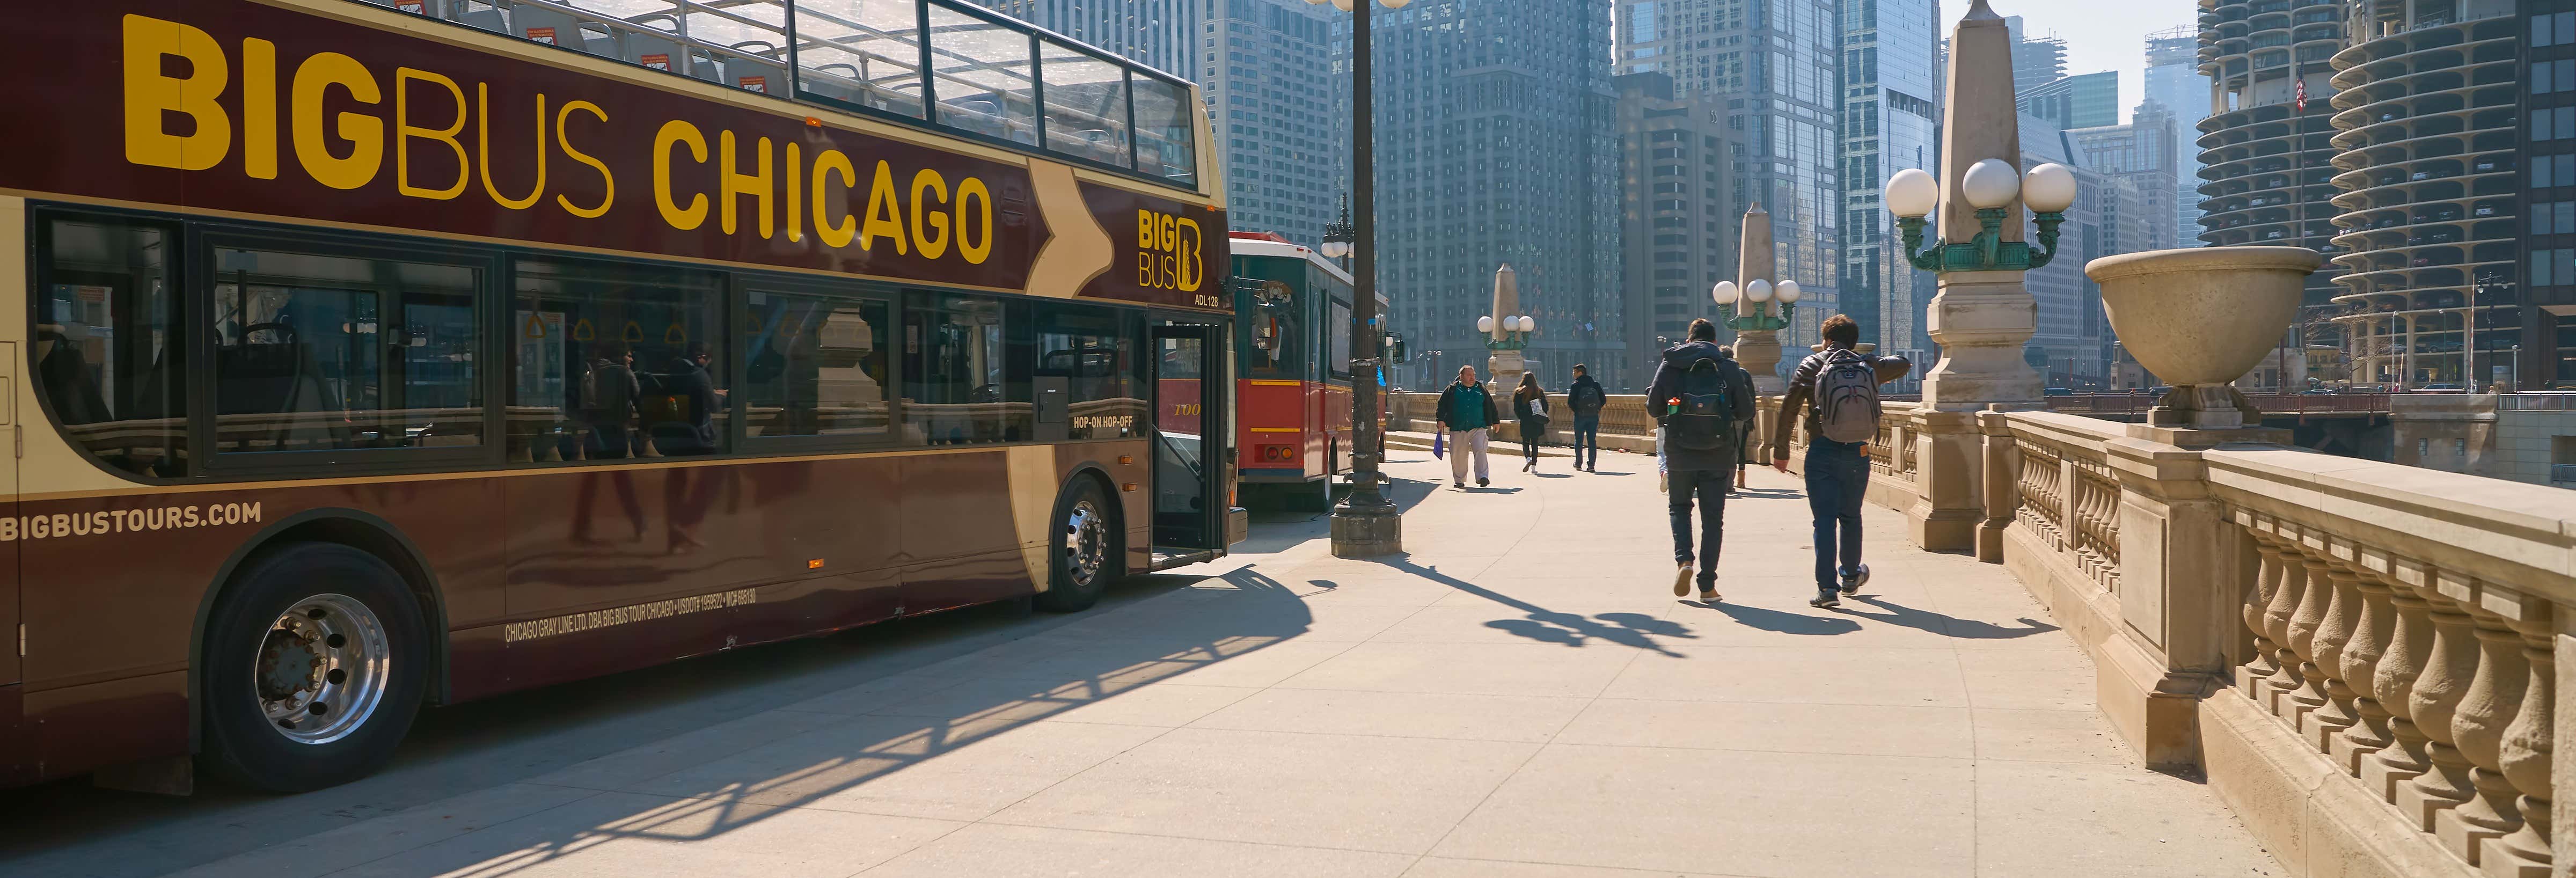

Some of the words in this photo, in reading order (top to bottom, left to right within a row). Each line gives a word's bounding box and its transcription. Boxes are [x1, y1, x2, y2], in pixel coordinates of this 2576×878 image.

[653, 120, 992, 265] CHICAGO
[1138, 209, 1175, 252] BIG
[1139, 252, 1175, 289] BUS
[1195, 294, 1207, 306] ADL
[1208, 296, 1218, 307] 128
[1074, 416, 1101, 428] HOP-ON
[1103, 415, 1133, 428] HOP-OFF
[1174, 404, 1201, 416] 100
[0, 501, 261, 542] BIGBUSTOURS.COM
[505, 620, 537, 642] CHICAGO
[539, 617, 557, 637] GRAY
[558, 615, 573, 634] LINE
[574, 613, 588, 632] LTD.
[589, 611, 602, 629] DBA
[603, 608, 614, 627] BIG
[616, 606, 628, 625] BUS
[628, 604, 646, 623] TOUR
[647, 599, 674, 620] CHICAGO
[678, 597, 700, 615] USDOT#
[700, 592, 722, 611] 1959522
[726, 591, 737, 607] MC#
[738, 588, 756, 605] 695130
